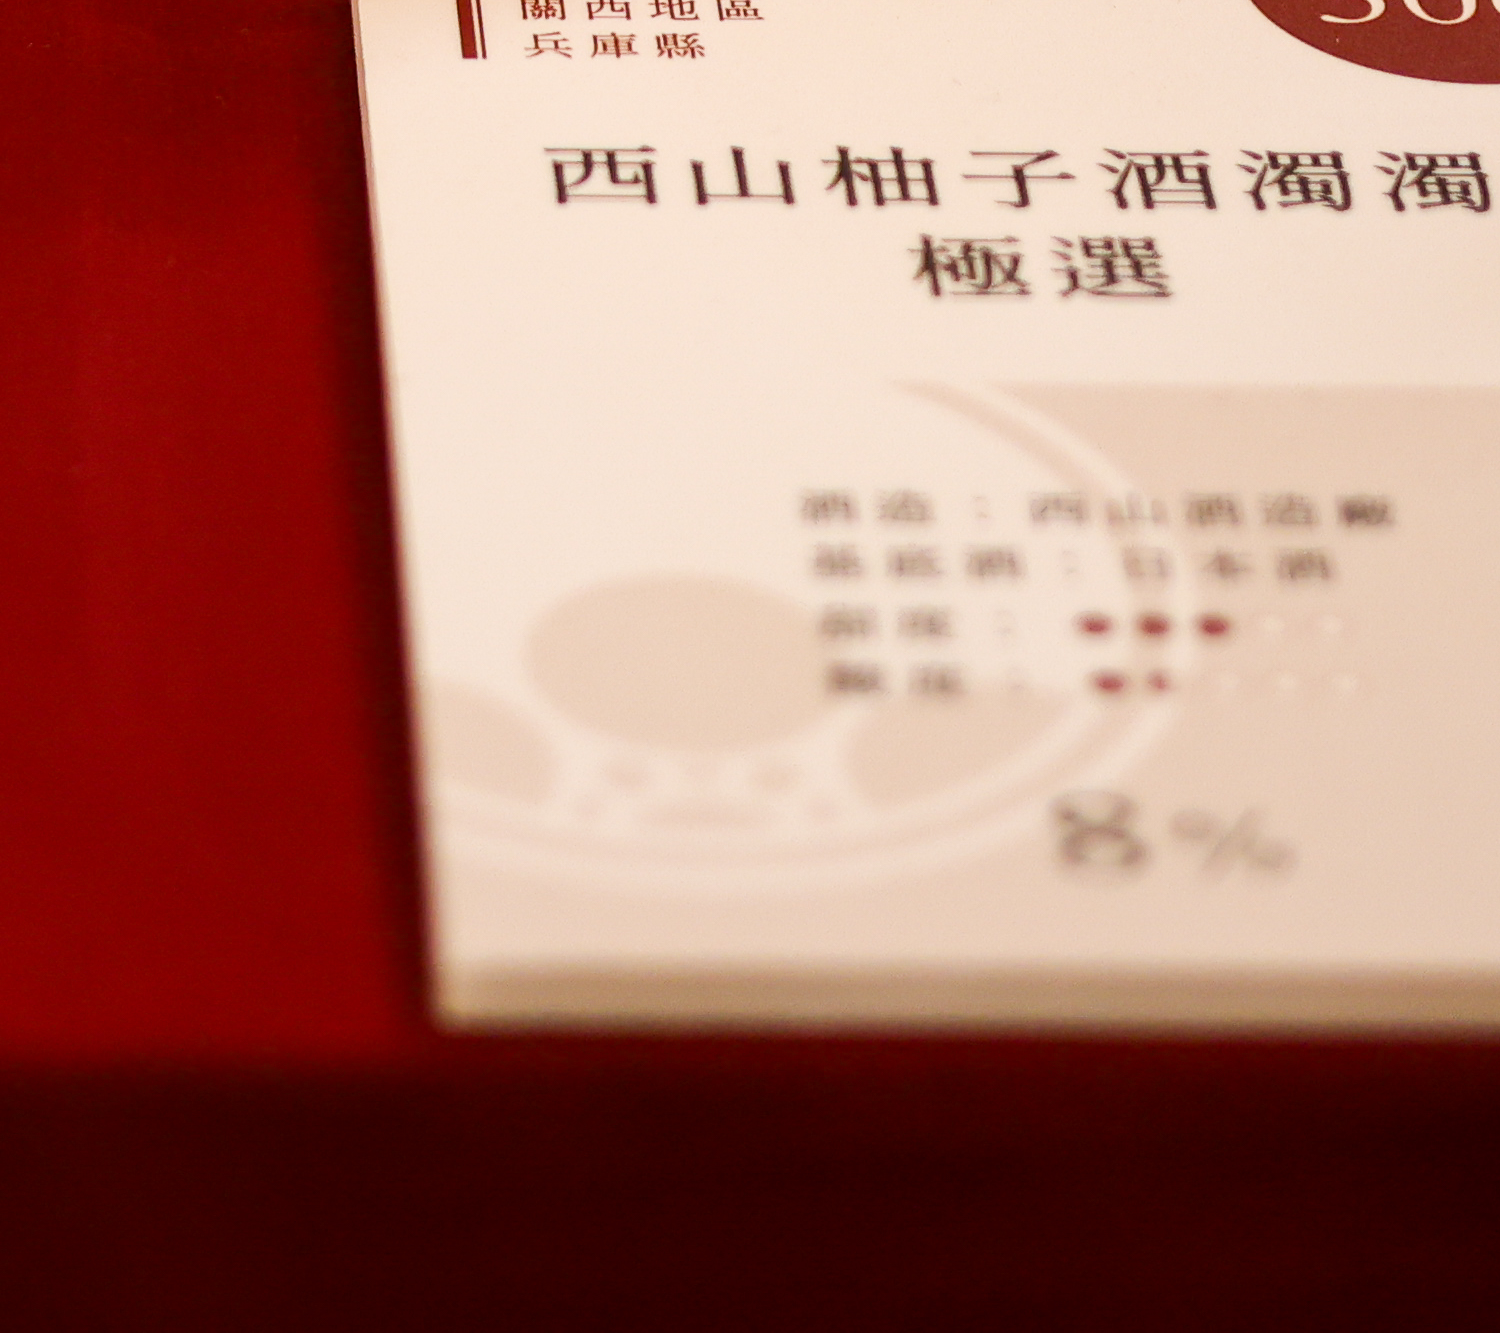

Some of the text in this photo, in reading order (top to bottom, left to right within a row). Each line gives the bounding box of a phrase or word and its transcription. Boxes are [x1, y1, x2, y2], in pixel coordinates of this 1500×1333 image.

[524, 30, 708, 60] 兵庫縣
[543, 144, 1494, 214] 西山柚子酒濁濁
[911, 234, 1172, 300] 極選
